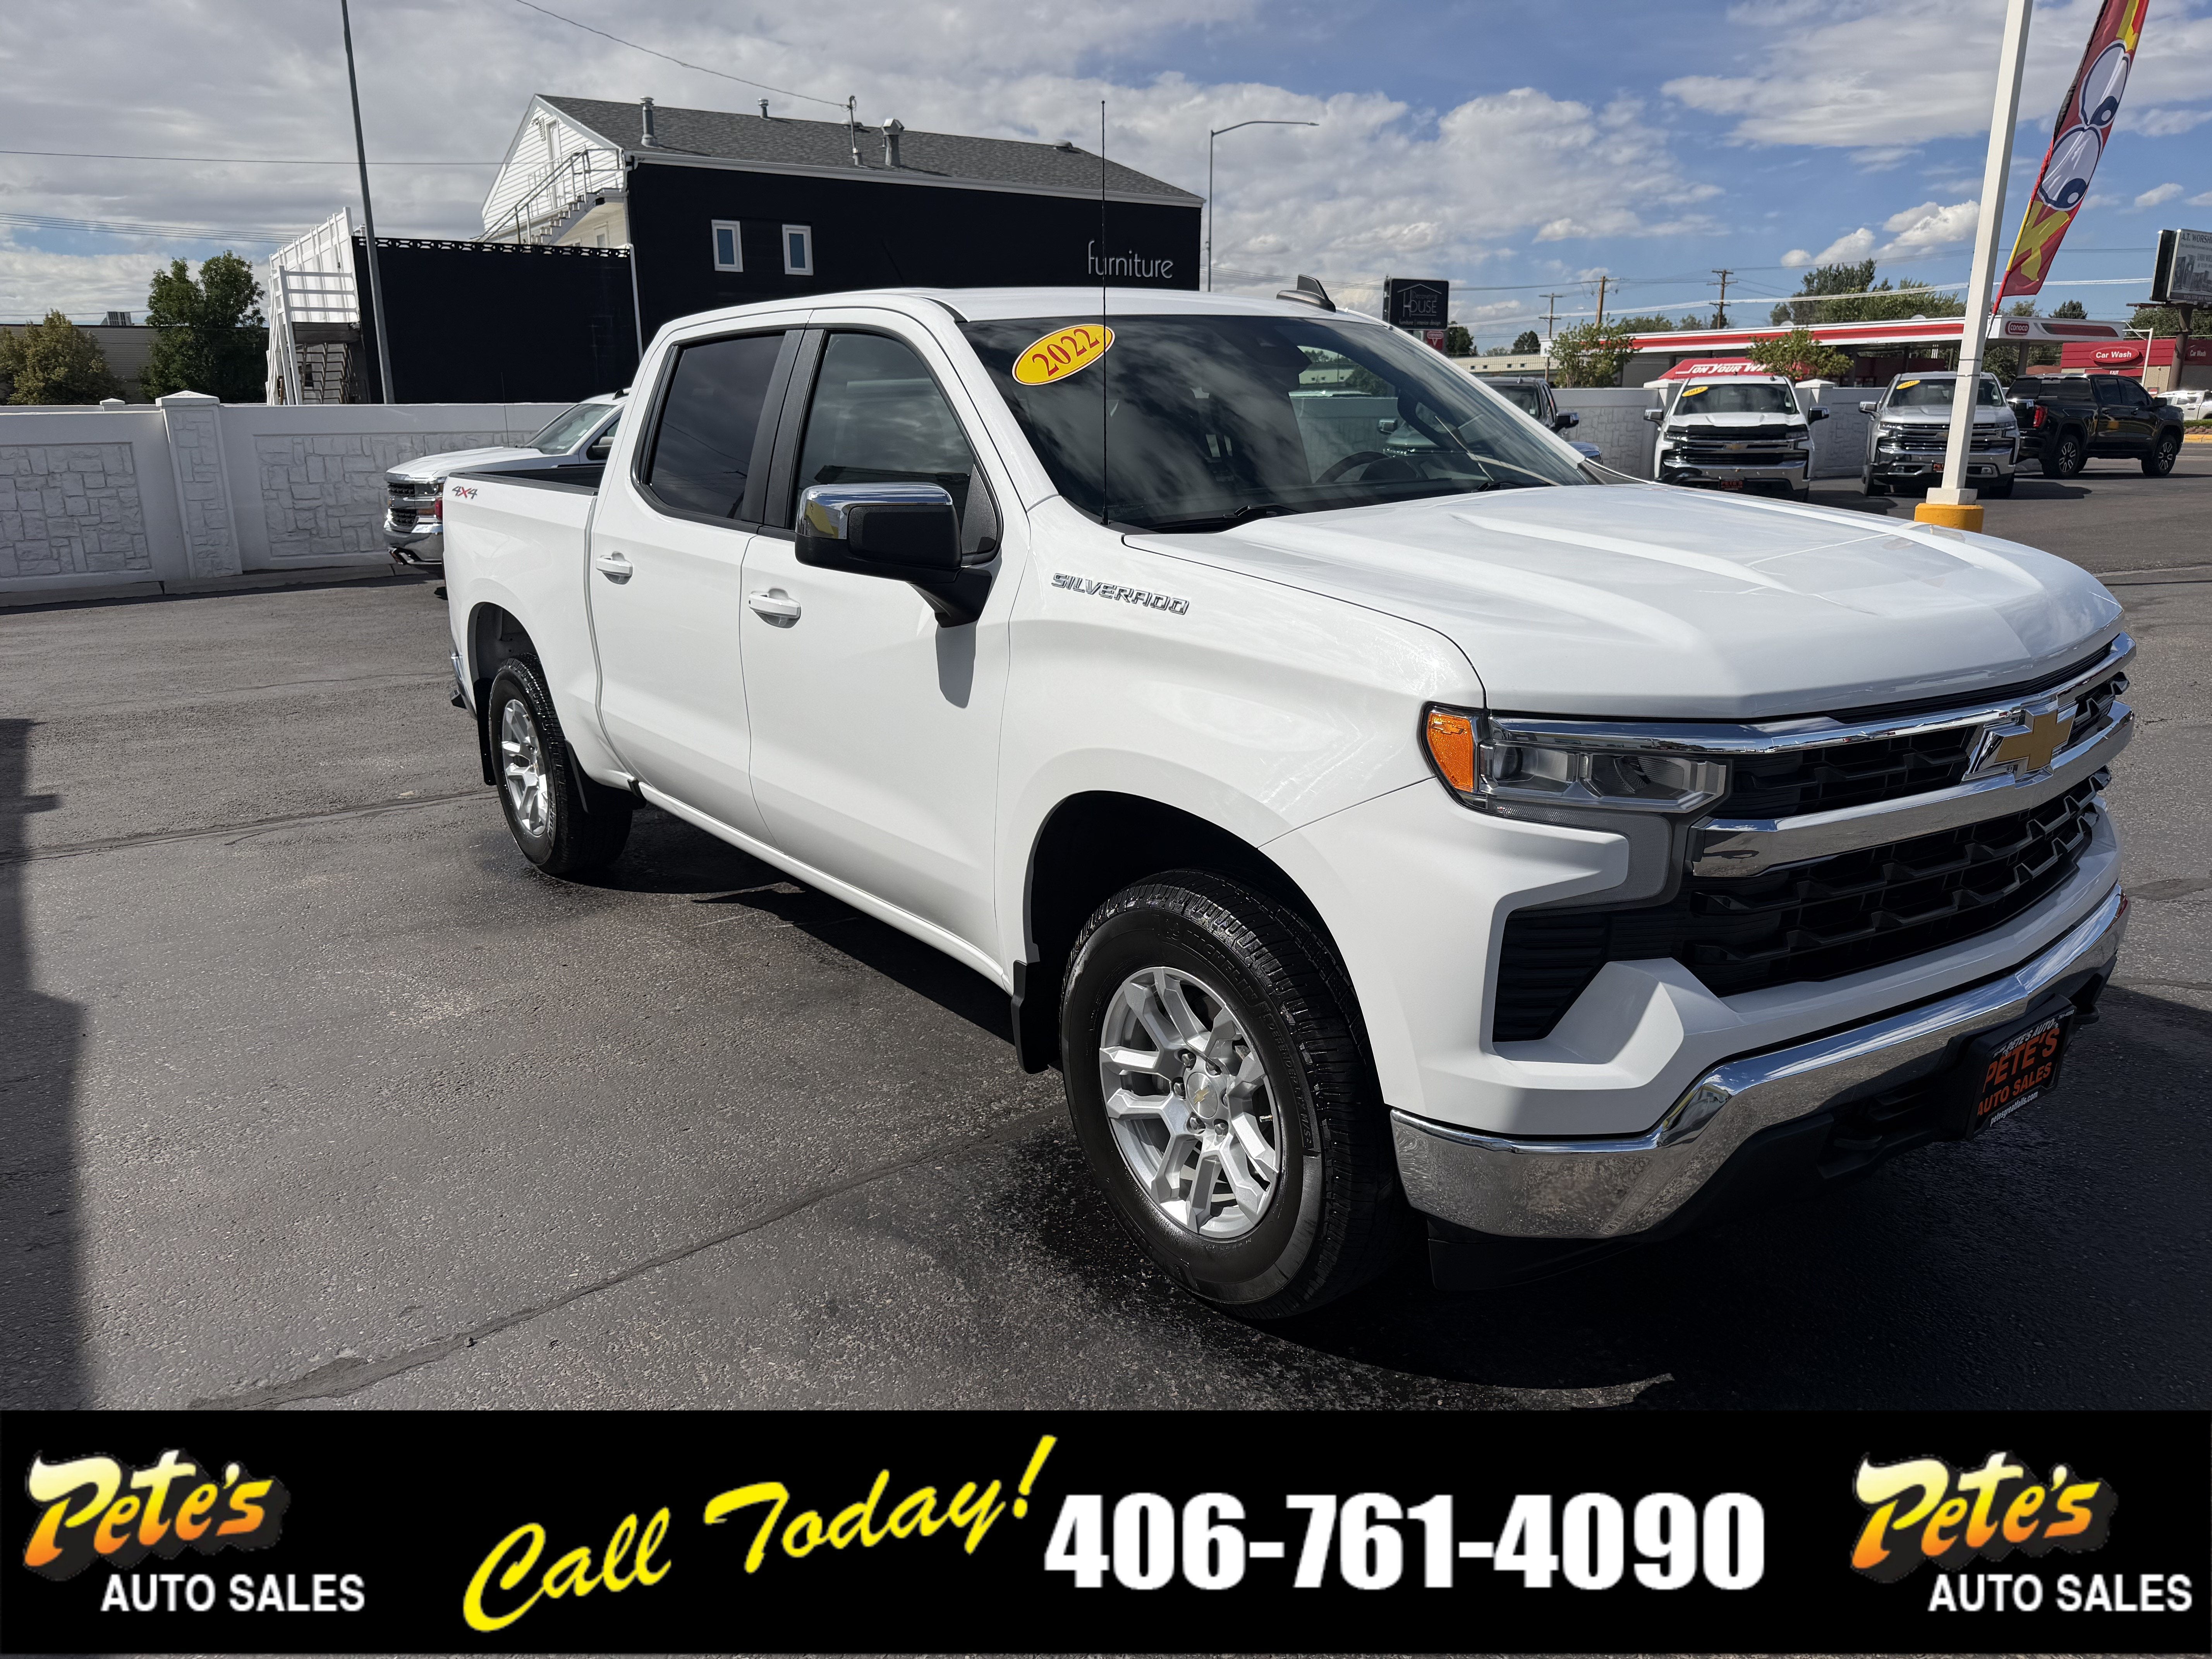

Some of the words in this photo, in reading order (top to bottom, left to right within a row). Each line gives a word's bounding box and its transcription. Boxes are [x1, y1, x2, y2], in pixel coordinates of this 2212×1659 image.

[1087, 239, 1174, 279] furniture
[1032, 328, 1101, 377] 2022
[1051, 572, 1190, 615] SILVERADO
[1982, 1027, 2060, 1093] PETE'S
[1977, 1085, 2010, 1116] AUTO
[2013, 1062, 2052, 1096] SALES
[1990, 1091, 2039, 1127] petesgreatfalls.com
